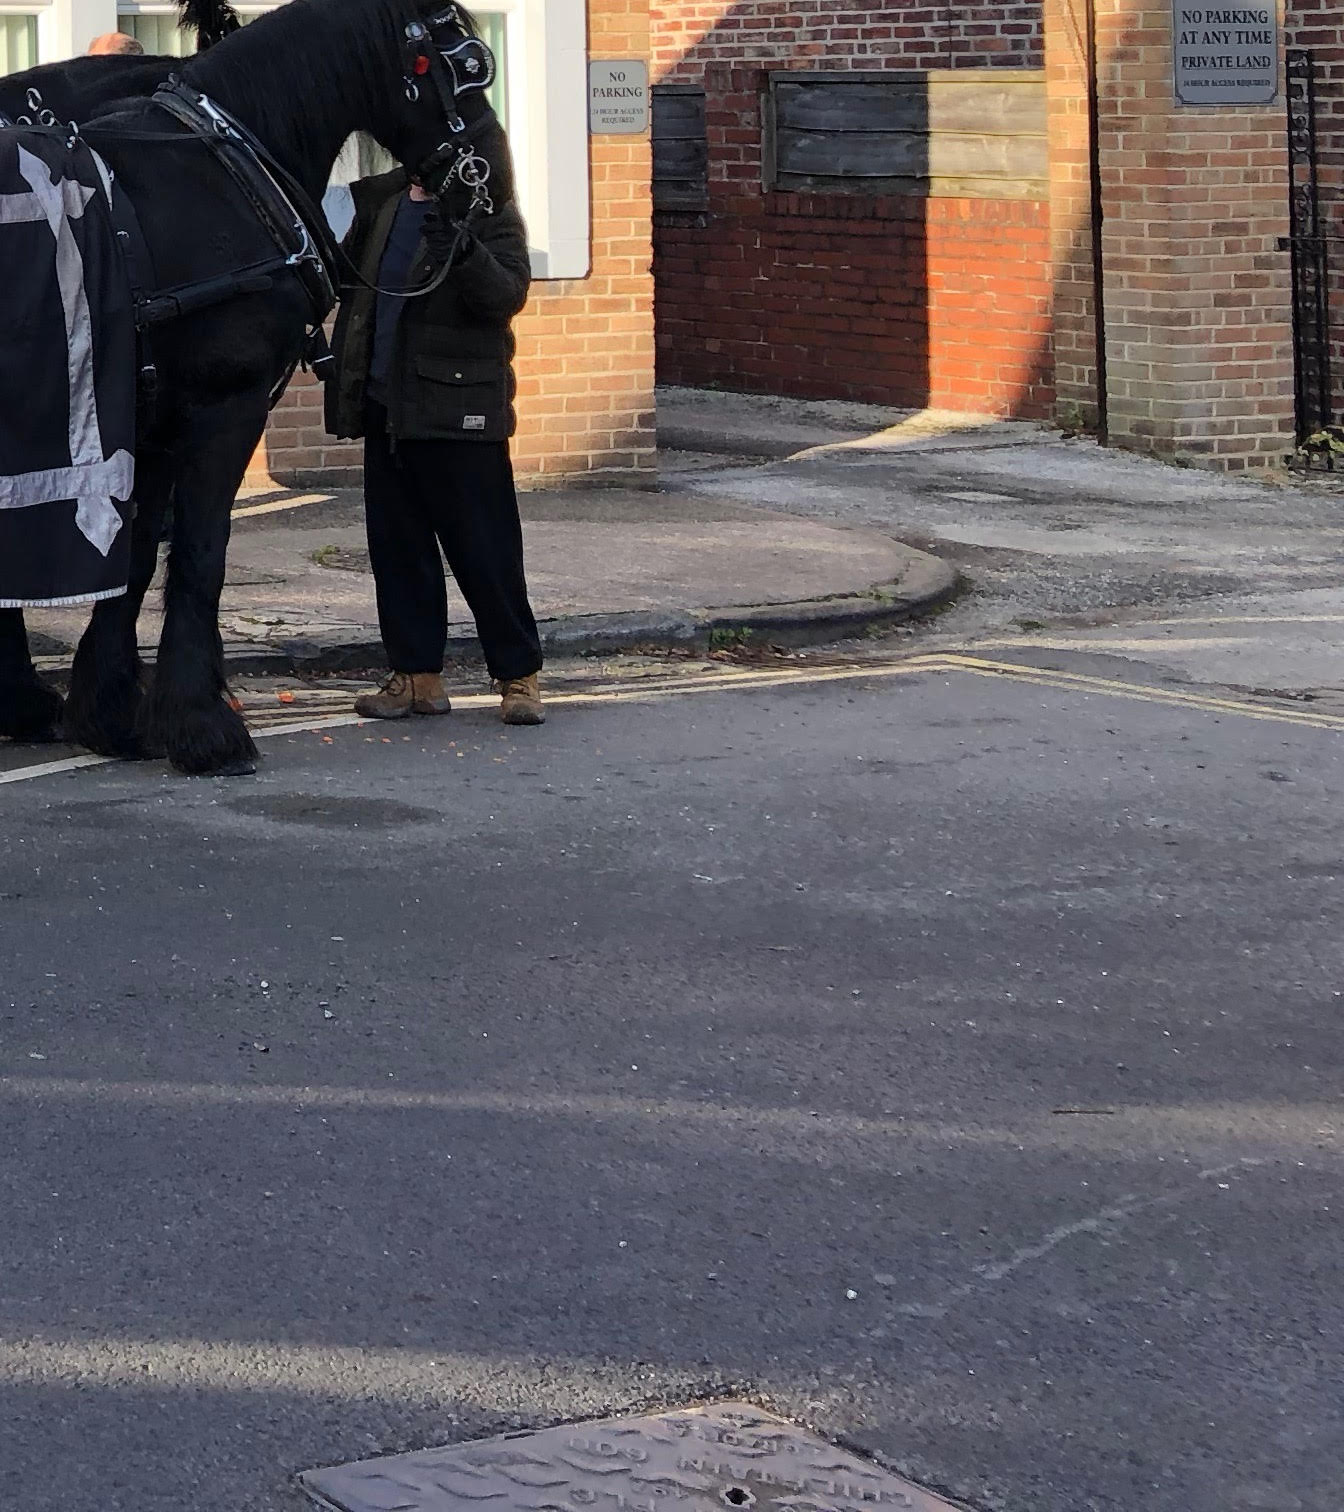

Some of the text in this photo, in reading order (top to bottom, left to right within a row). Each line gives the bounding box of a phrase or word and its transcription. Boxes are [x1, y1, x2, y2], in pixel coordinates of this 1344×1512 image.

[1181, 10, 1269, 24] NO PARKING
[1179, 31, 1272, 45] AT ANY TIME
[1181, 56, 1271, 68] PRIVATE LAND
[609, 71, 626, 82] NO
[592, 87, 643, 98] PARKING
